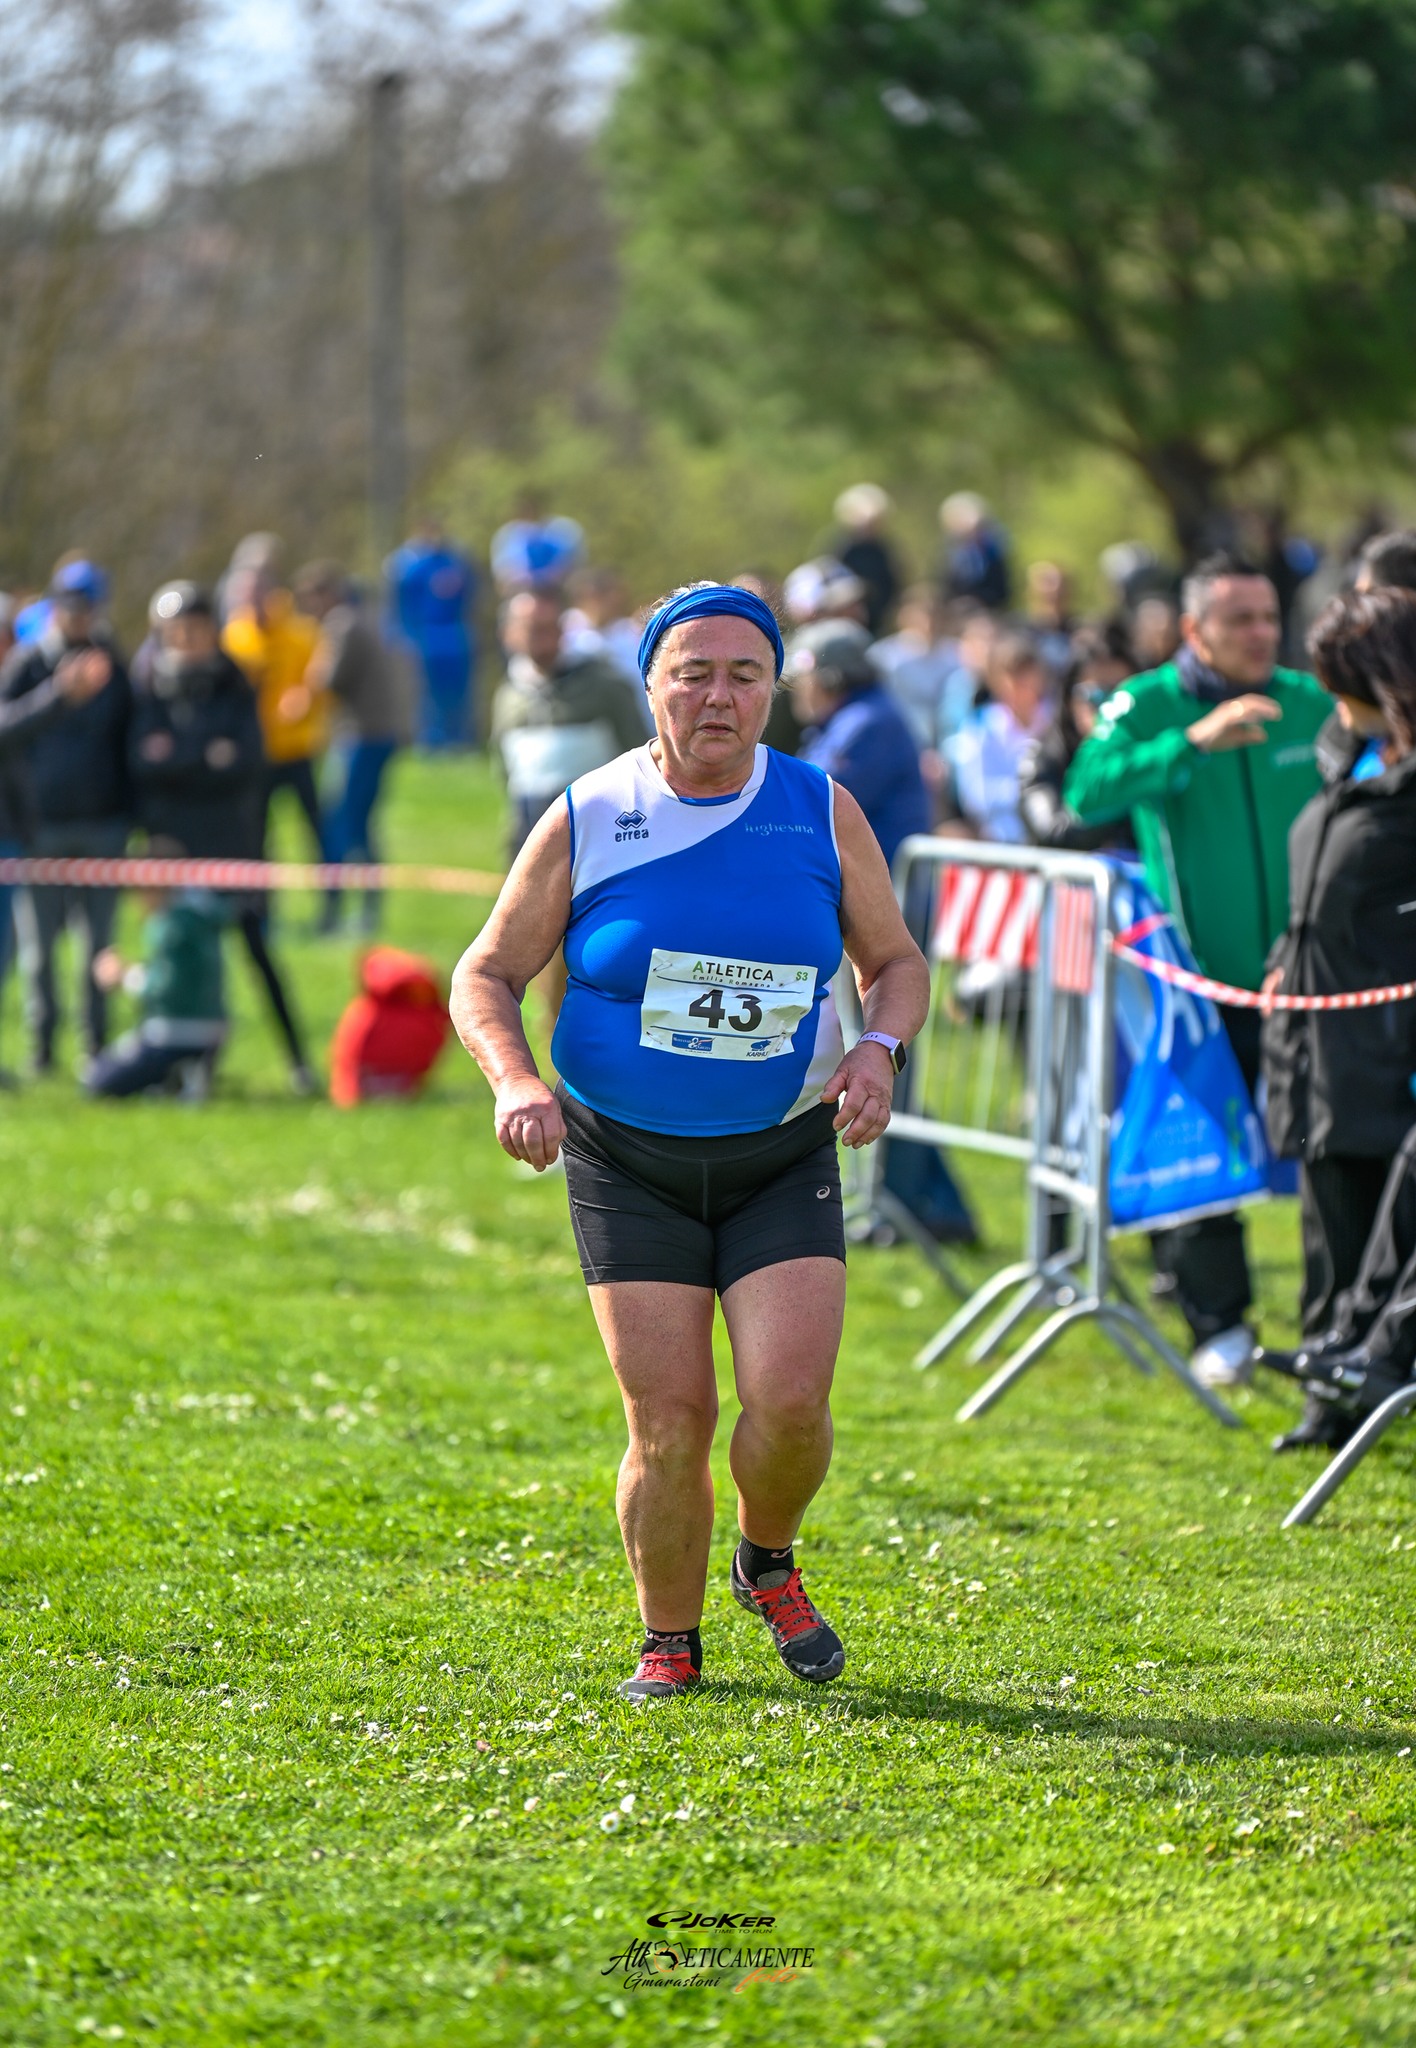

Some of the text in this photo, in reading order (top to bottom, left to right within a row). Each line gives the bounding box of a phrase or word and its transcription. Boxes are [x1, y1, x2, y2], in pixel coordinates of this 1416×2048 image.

[615, 829, 649, 842] errea
[693, 960, 774, 982] ATLETICA
[796, 971, 809, 981] S3
[693, 974, 771, 988] Emilia Romagna
[688, 989, 763, 1032] 43
